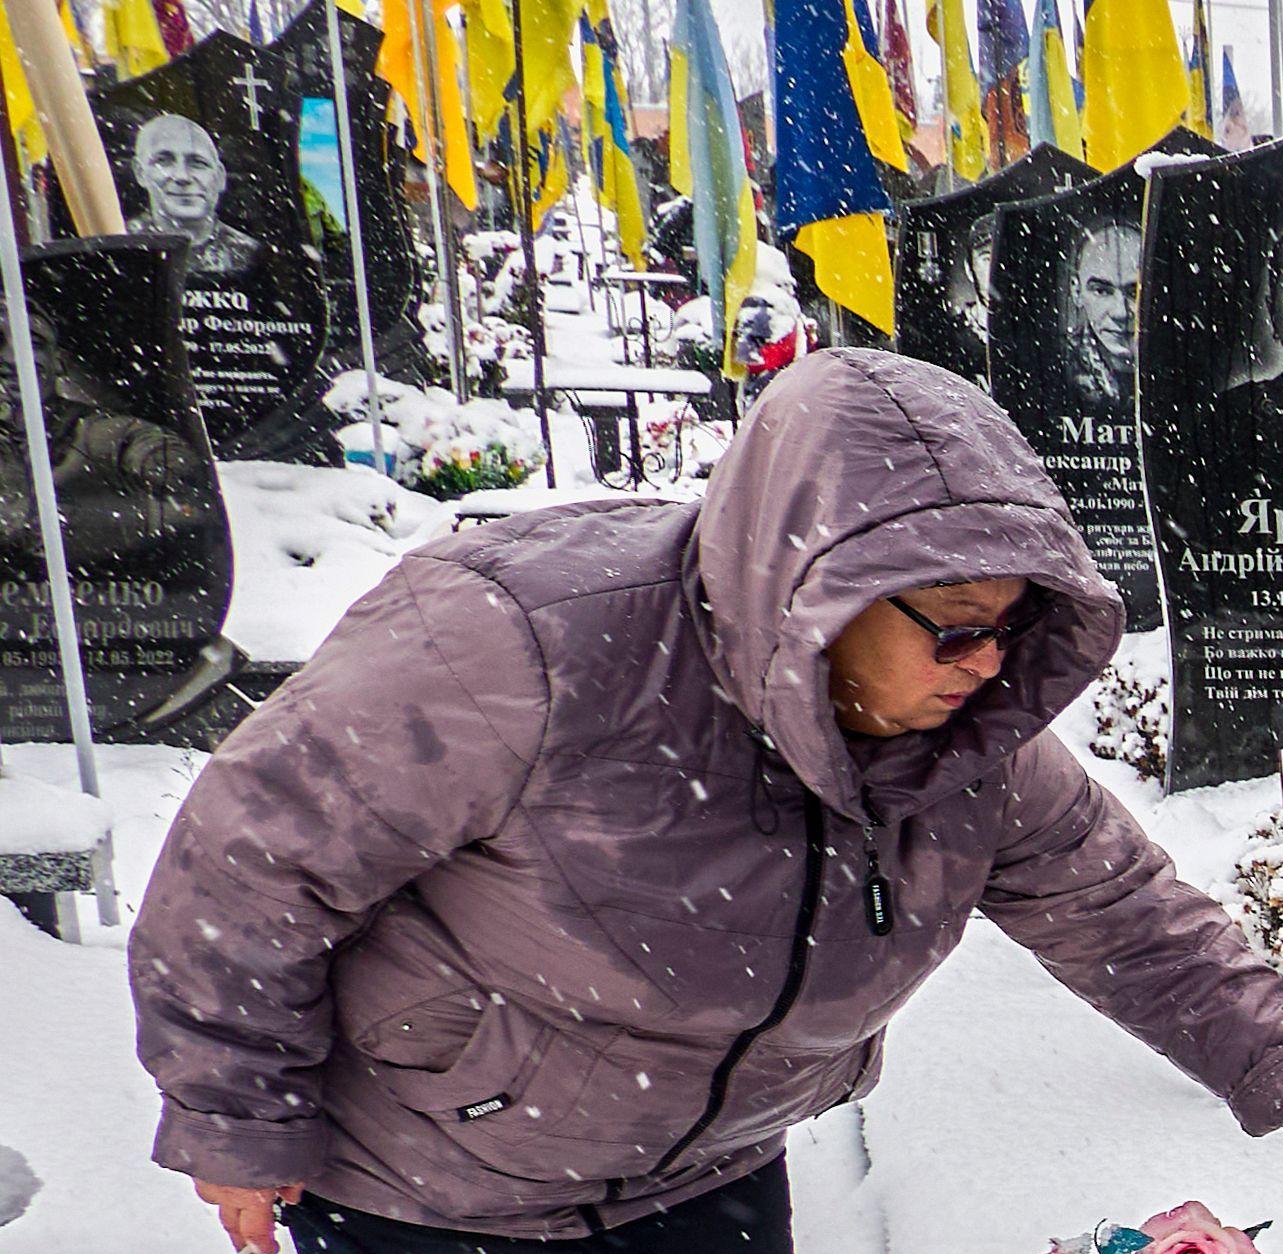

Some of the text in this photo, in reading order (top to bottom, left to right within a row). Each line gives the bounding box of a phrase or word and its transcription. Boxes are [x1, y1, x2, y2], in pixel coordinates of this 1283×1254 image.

[1059, 416, 1138, 445] Мат
[1178, 547, 1282, 579] Андрій
[1203, 626, 1225, 640] Не
[1204, 645, 1224, 659] Бо
[1227, 648, 1277, 659] важко
[1204, 666, 1232, 682] Що
[1235, 669, 1254, 680] ти
[1257, 669, 1276, 680] не
[1204, 685, 1239, 699] Твій
